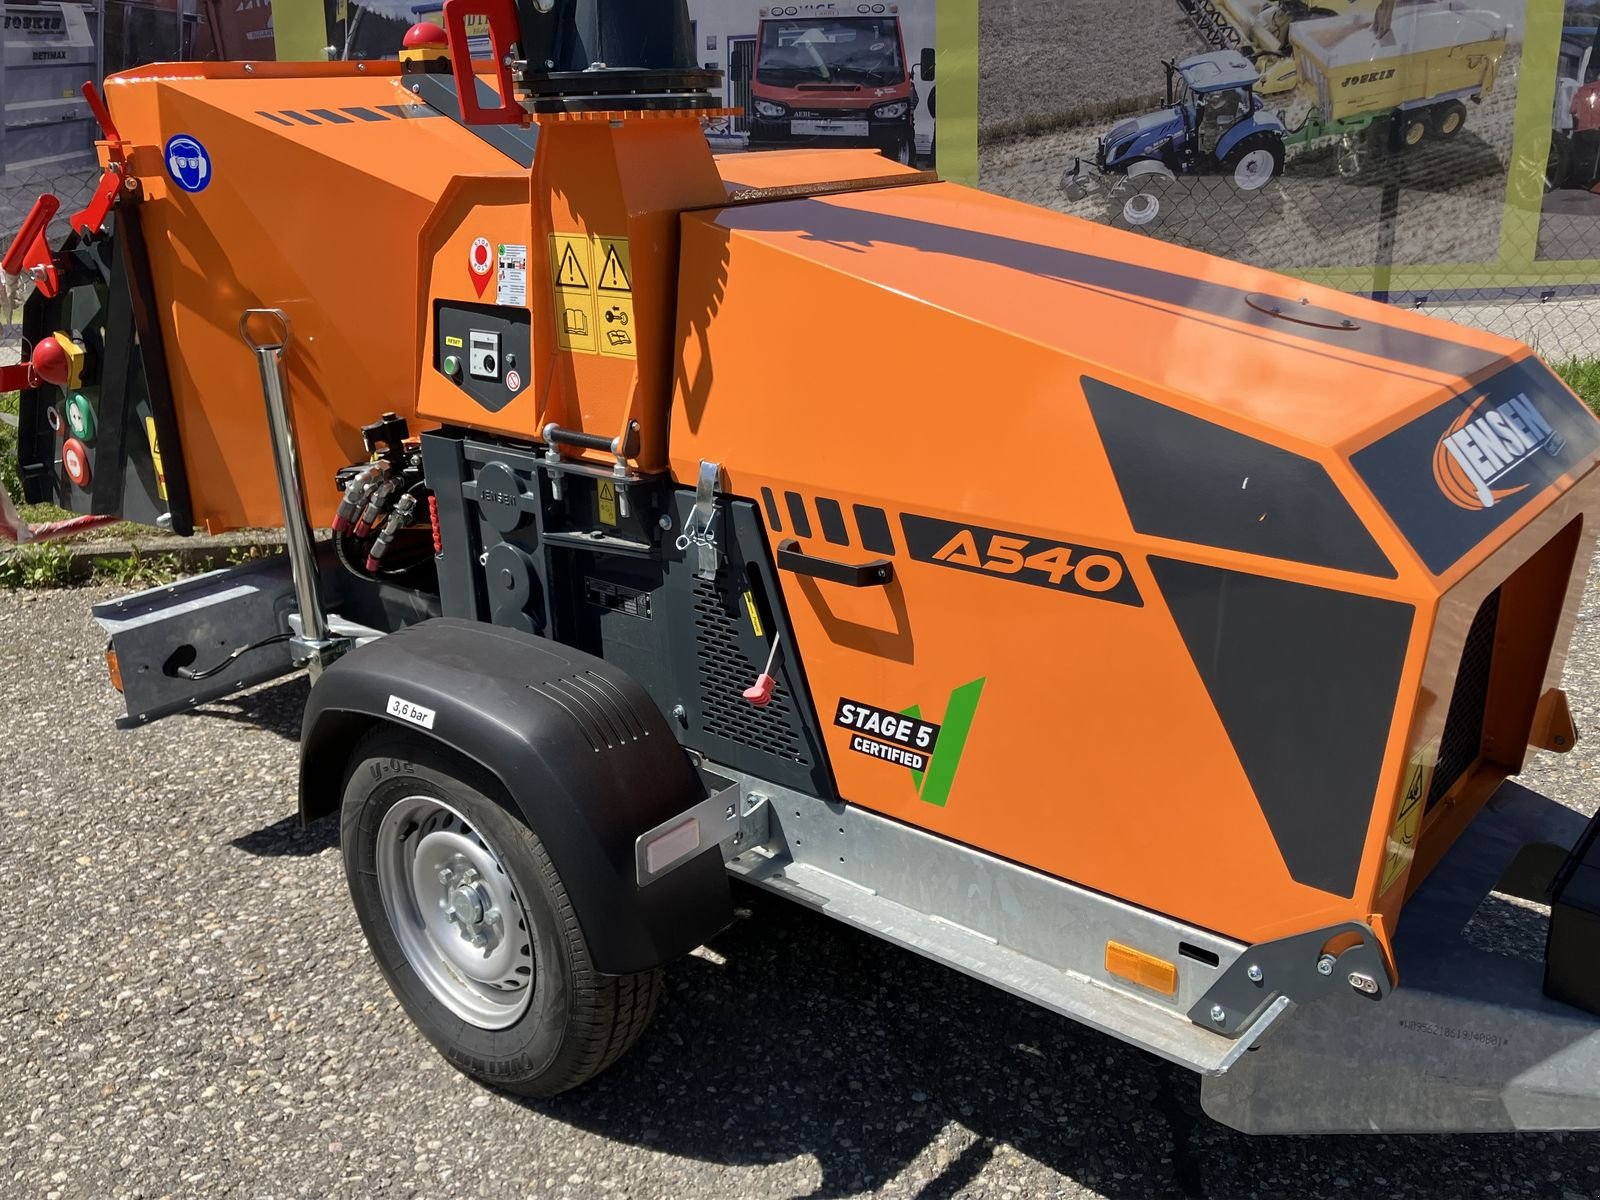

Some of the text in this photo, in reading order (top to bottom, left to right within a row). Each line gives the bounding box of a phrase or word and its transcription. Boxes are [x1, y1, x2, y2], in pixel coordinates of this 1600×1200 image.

[32, 51, 66, 60] BETIMAX
[1341, 69, 1396, 87] JOSKIN
[1443, 393, 1553, 508] JENSEN
[931, 529, 1123, 592] A540
[392, 701, 428, 722] 3,6 bar
[839, 704, 933, 747] STAGE 5
[853, 737, 923, 769] CERTIFIED
